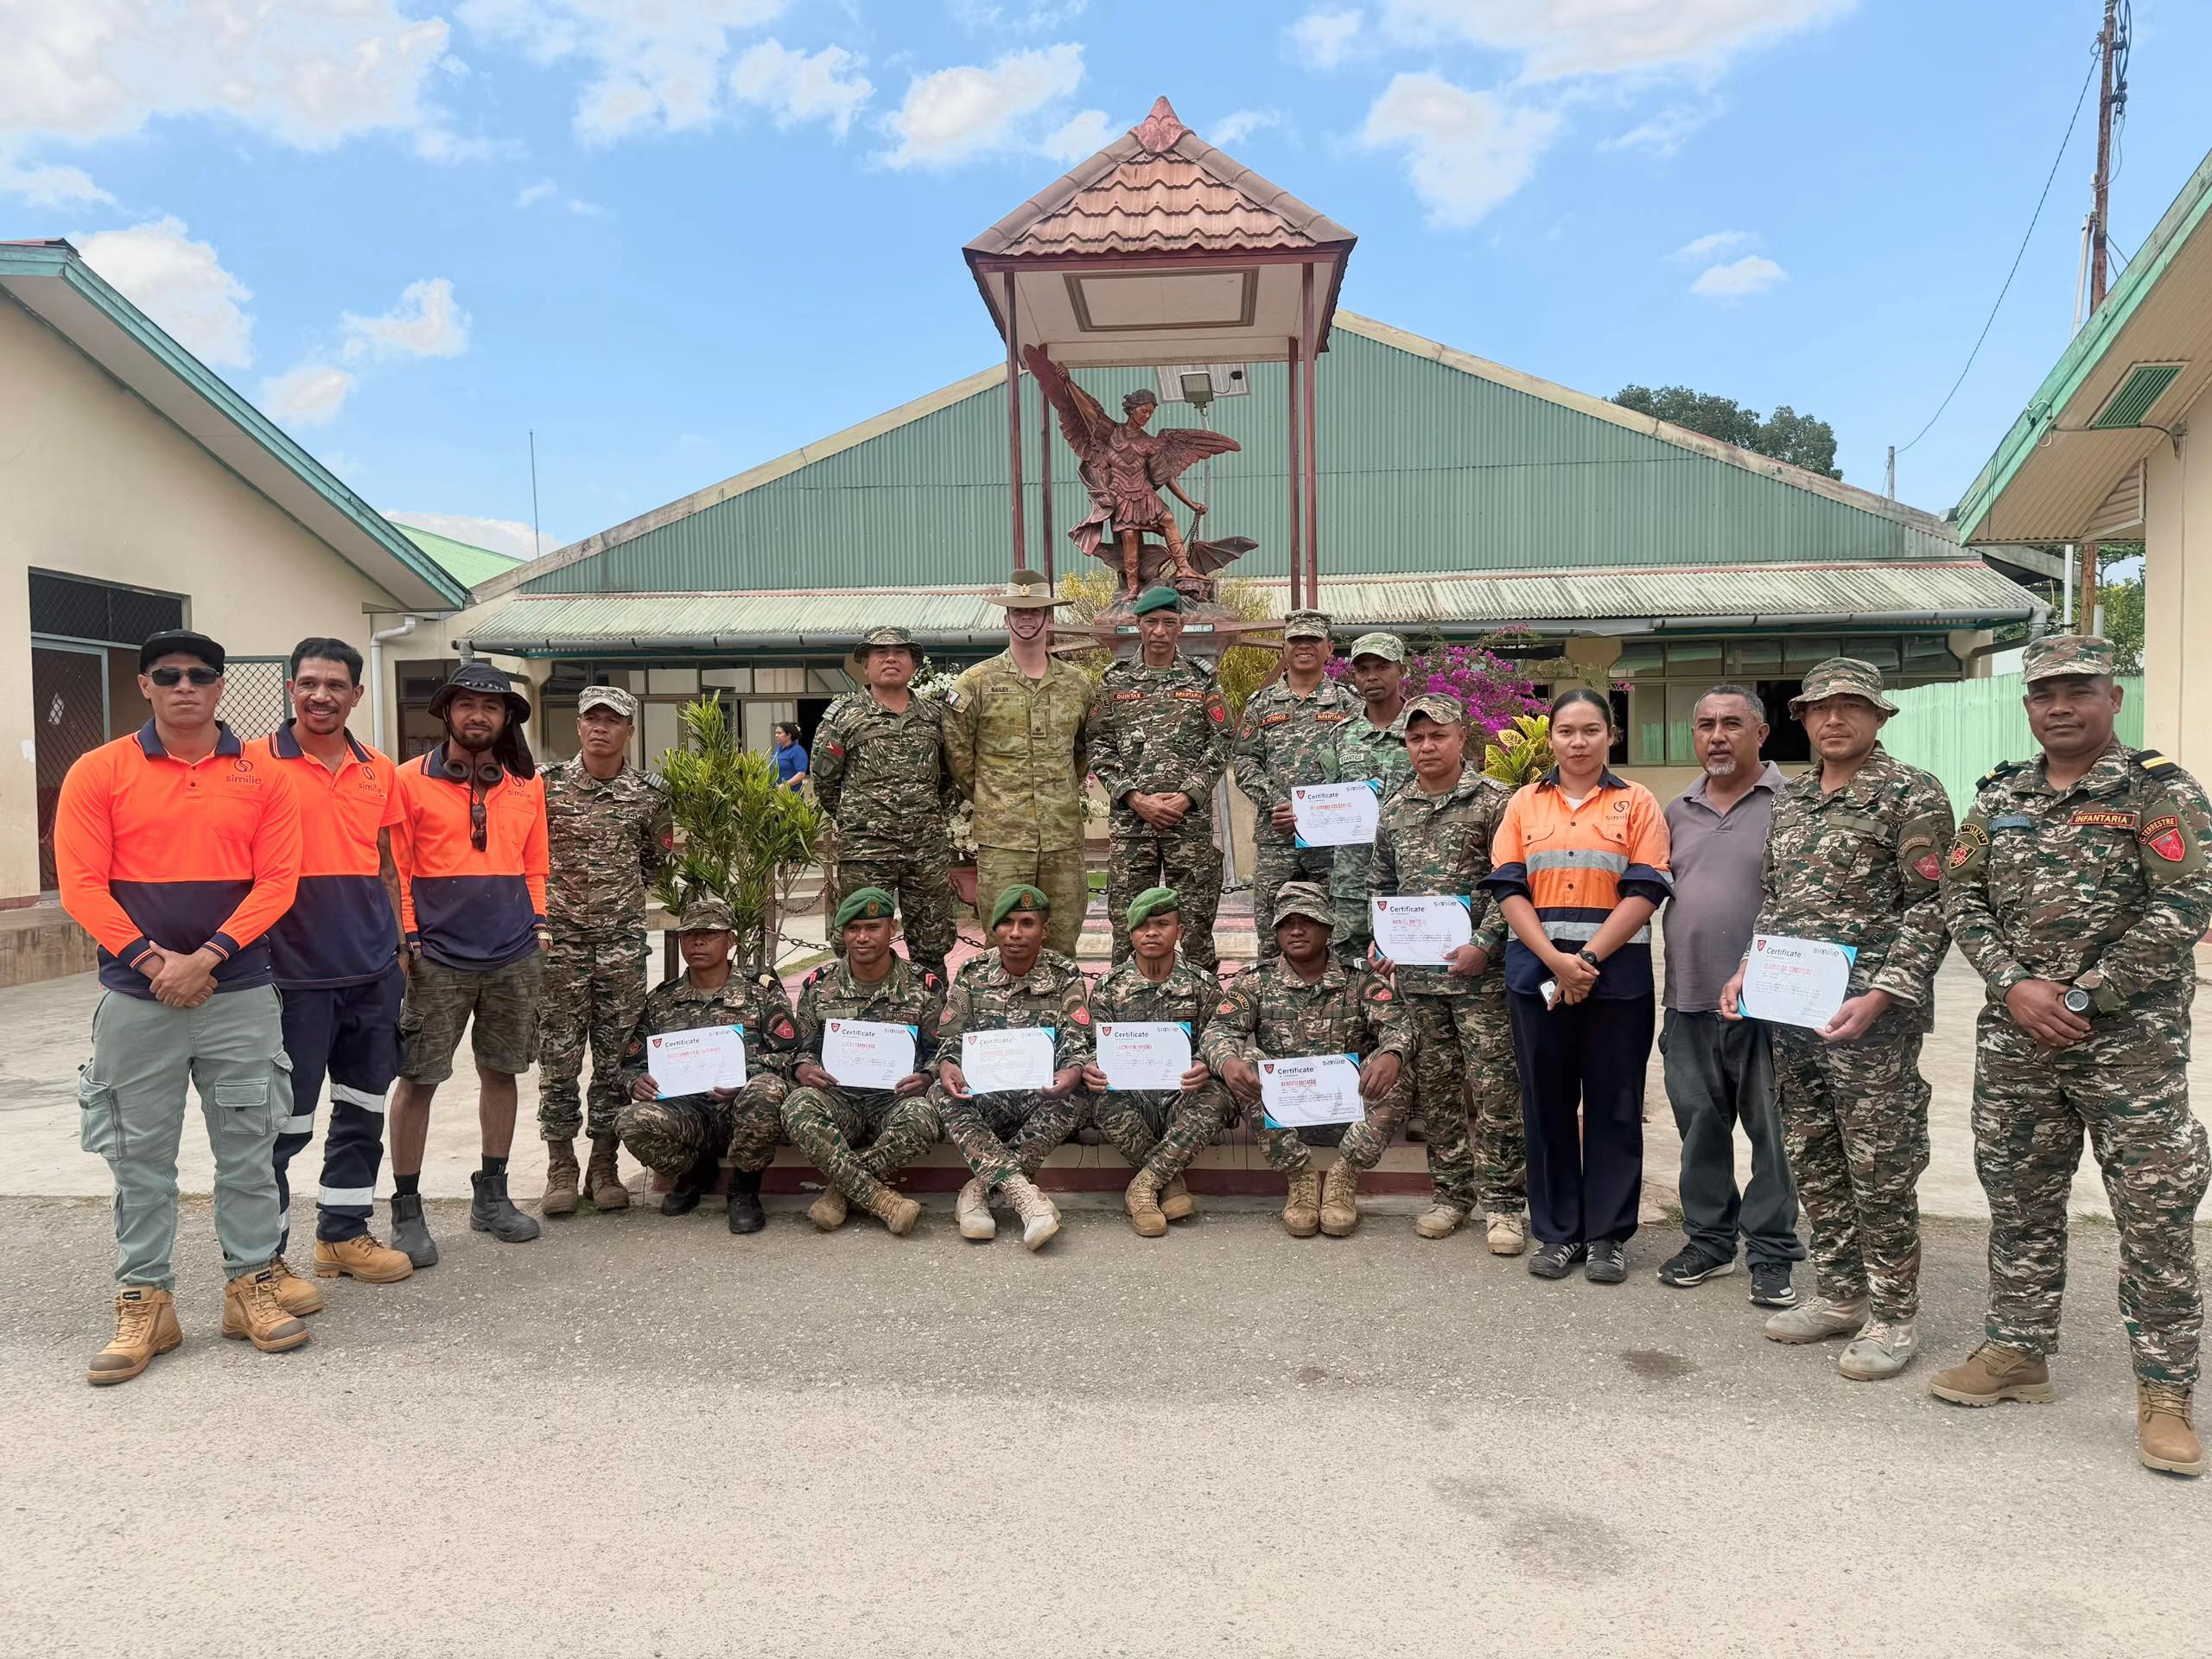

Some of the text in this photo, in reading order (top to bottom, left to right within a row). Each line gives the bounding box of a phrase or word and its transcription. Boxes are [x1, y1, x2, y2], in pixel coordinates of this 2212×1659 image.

[226, 773, 262, 785] similie
[2075, 814, 2127, 824] INFANTARIA
[1766, 947, 1802, 958] Certificate
[665, 1038, 700, 1048] Certificate
[1277, 1066, 1313, 1075] Certificate
